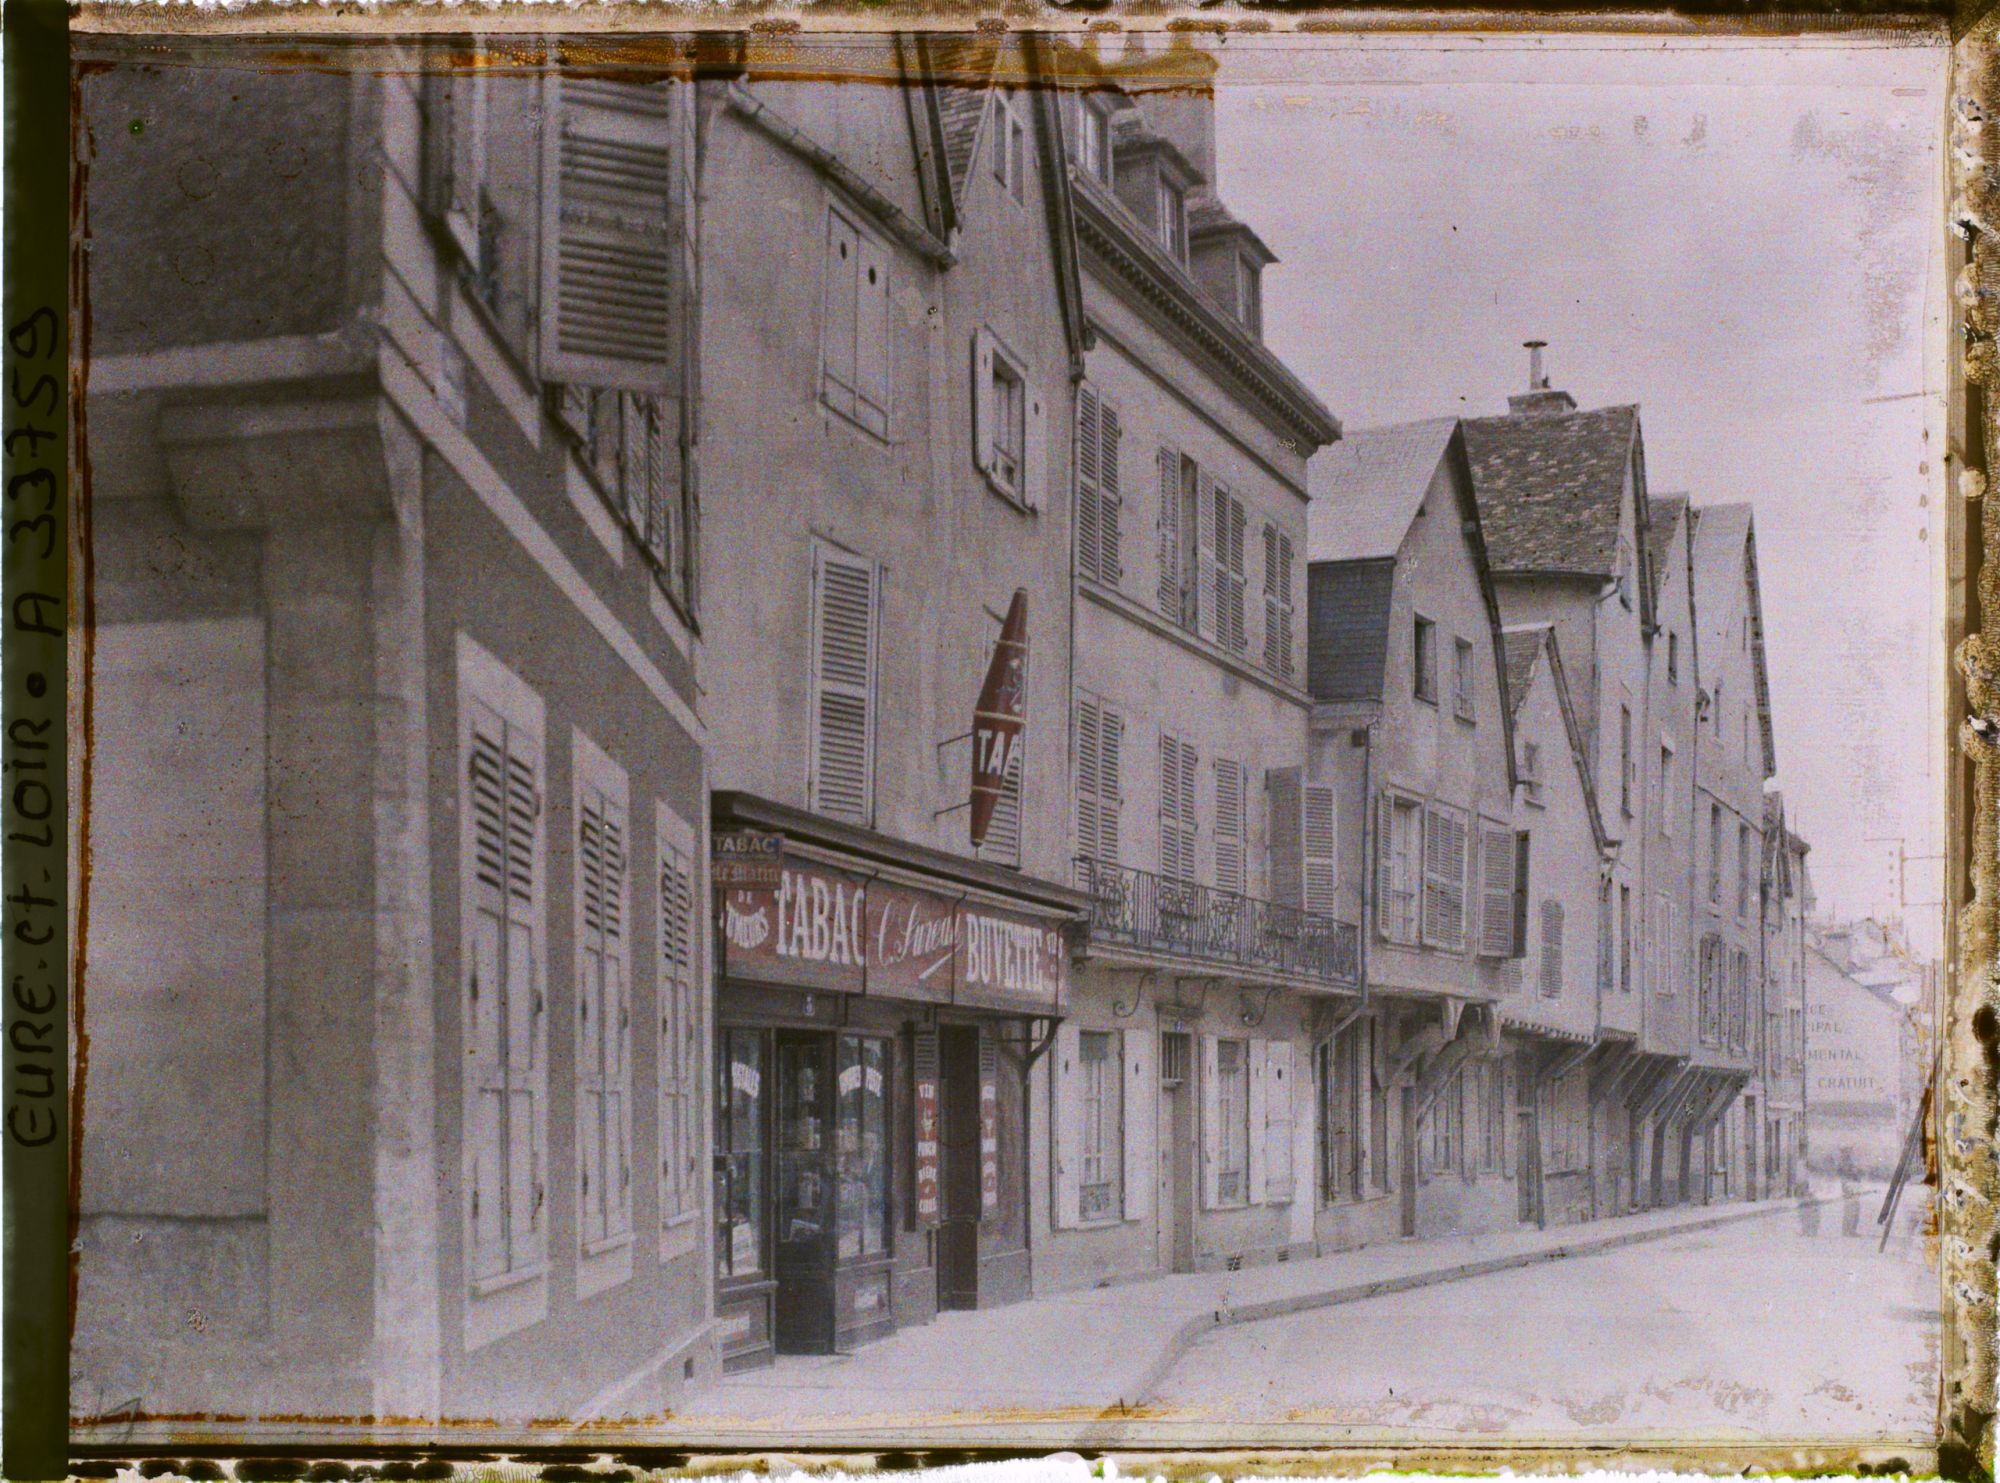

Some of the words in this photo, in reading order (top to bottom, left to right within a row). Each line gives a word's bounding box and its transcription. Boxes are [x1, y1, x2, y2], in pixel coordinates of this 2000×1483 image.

[4, 306, 59, 560] 33759
[12, 592, 63, 638] A
[712, 836, 775, 853] TABAC
[774, 869, 867, 967] TABAC
[965, 912, 1043, 992] BUVETTE
